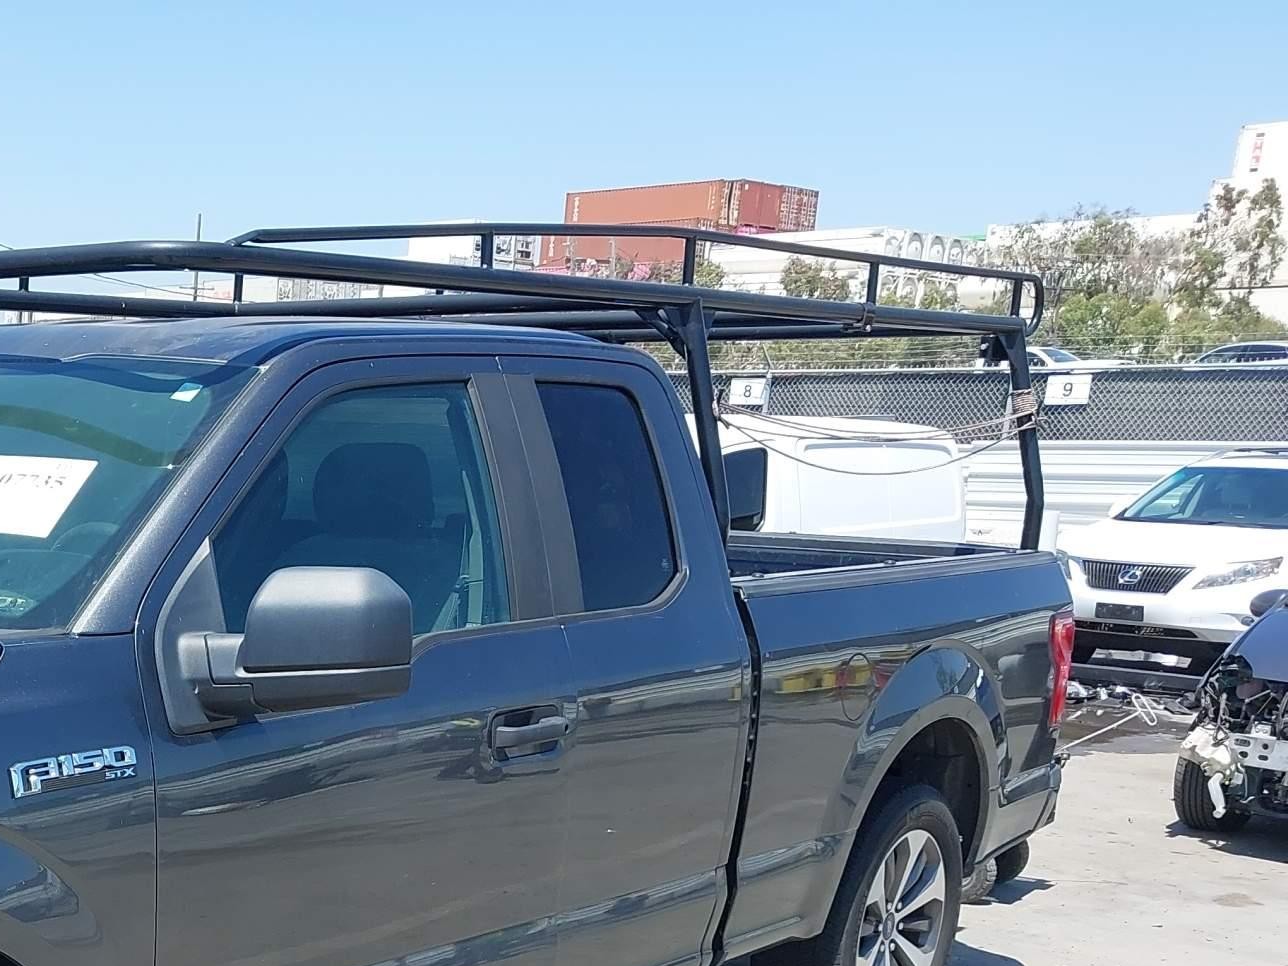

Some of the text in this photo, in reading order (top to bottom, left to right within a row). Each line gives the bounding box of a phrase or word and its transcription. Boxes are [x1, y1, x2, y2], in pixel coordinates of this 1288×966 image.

[743, 384, 752, 398] 8
[1062, 382, 1073, 397] 9
[105, 767, 136, 780] STX
